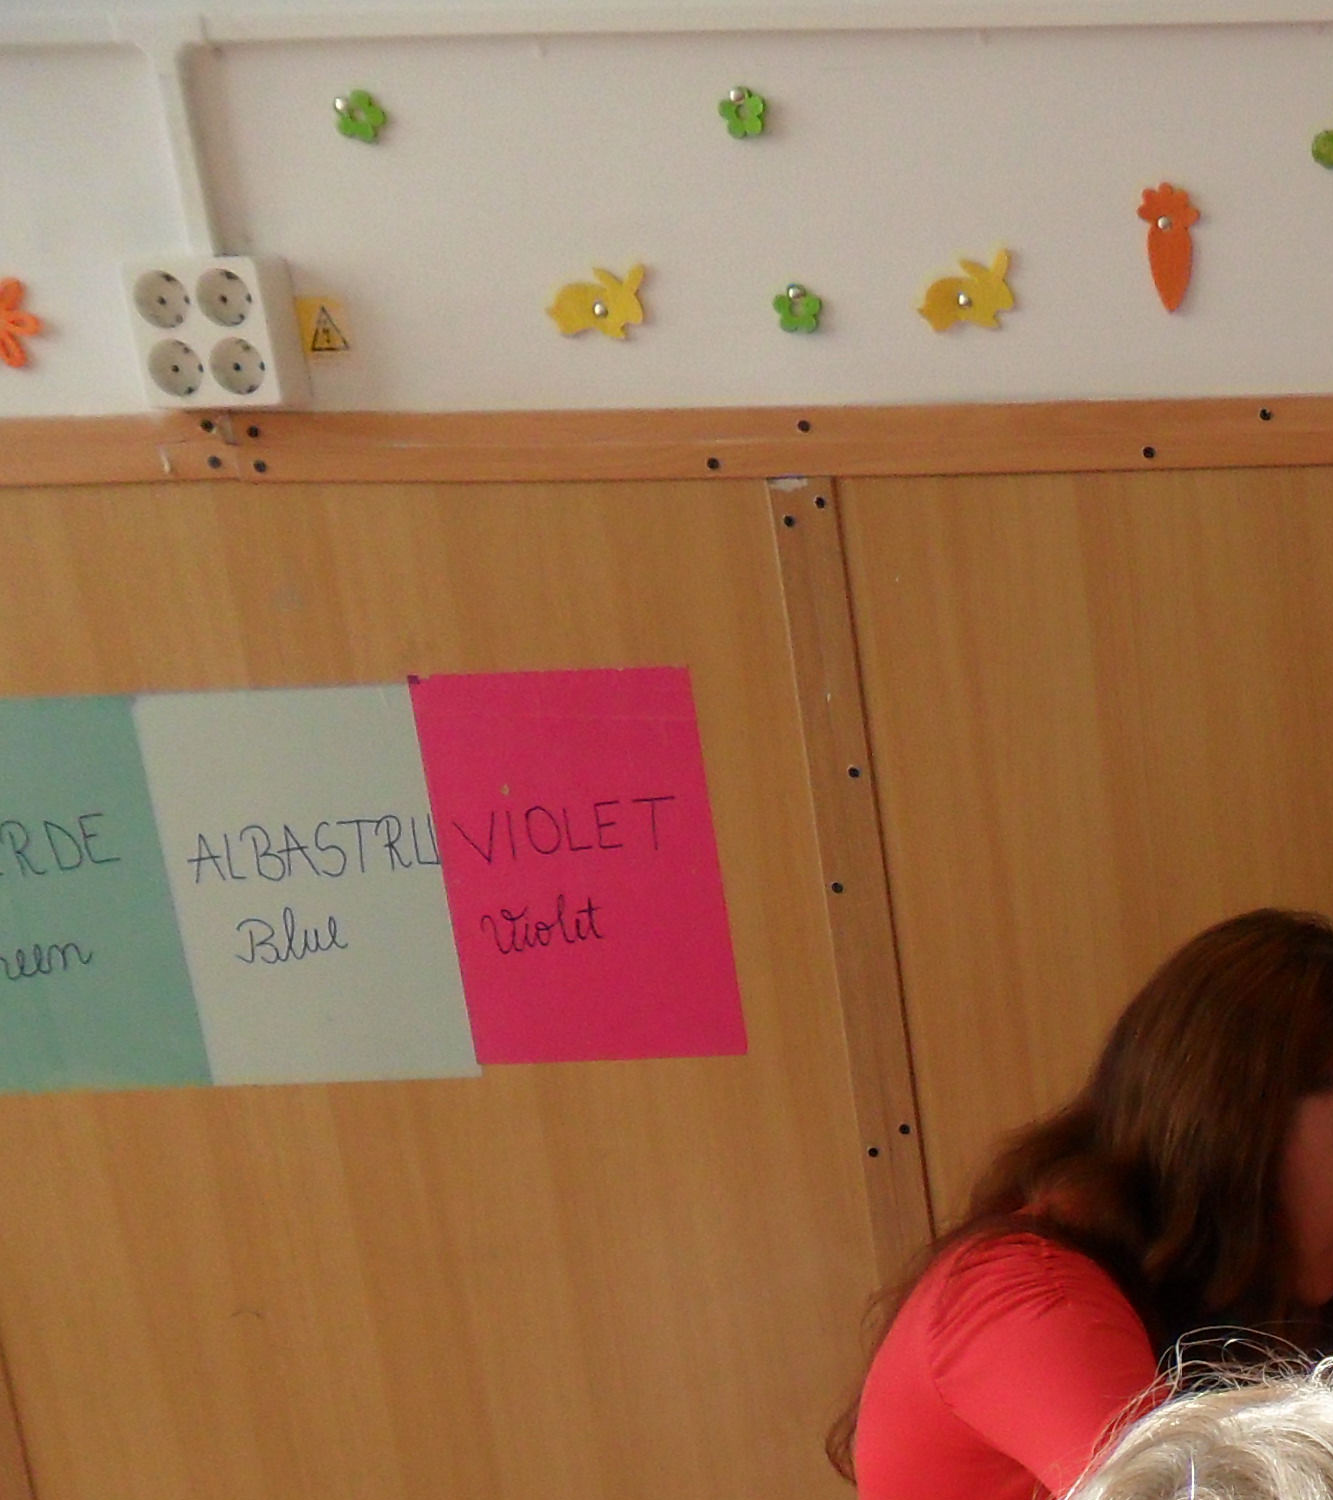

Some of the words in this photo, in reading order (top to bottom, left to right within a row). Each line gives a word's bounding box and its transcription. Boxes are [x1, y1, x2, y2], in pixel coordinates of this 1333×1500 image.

[0, 813, 121, 877] RDE
[187, 814, 441, 884] ALBASTRU
[452, 796, 675, 863] VIOLET
[235, 907, 349, 964] Blue
[481, 894, 605, 955] Violet
